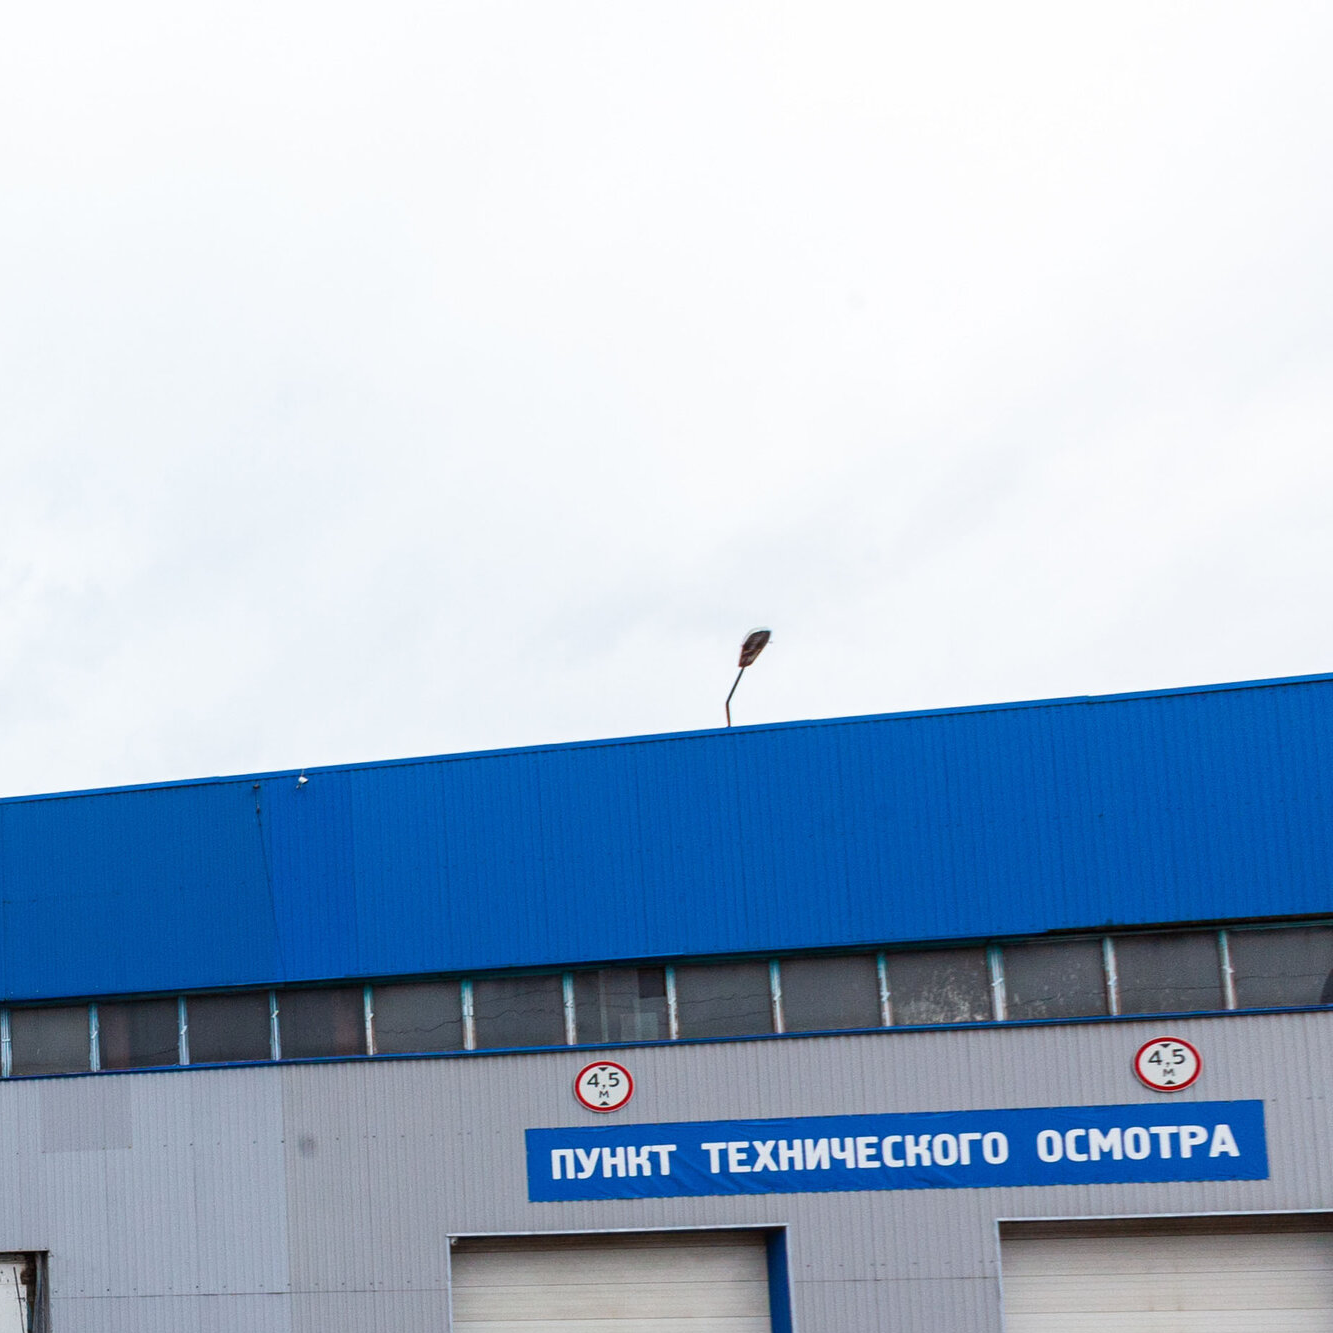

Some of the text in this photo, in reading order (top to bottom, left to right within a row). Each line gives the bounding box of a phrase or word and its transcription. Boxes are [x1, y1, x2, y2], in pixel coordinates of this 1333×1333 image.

[1148, 1048, 1186, 1067] 4,5
[586, 1072, 620, 1089] 4,5
[551, 1123, 1241, 1180] ПУНКТ ТЕХНИЧЕСКОГО ОСМОТРА
